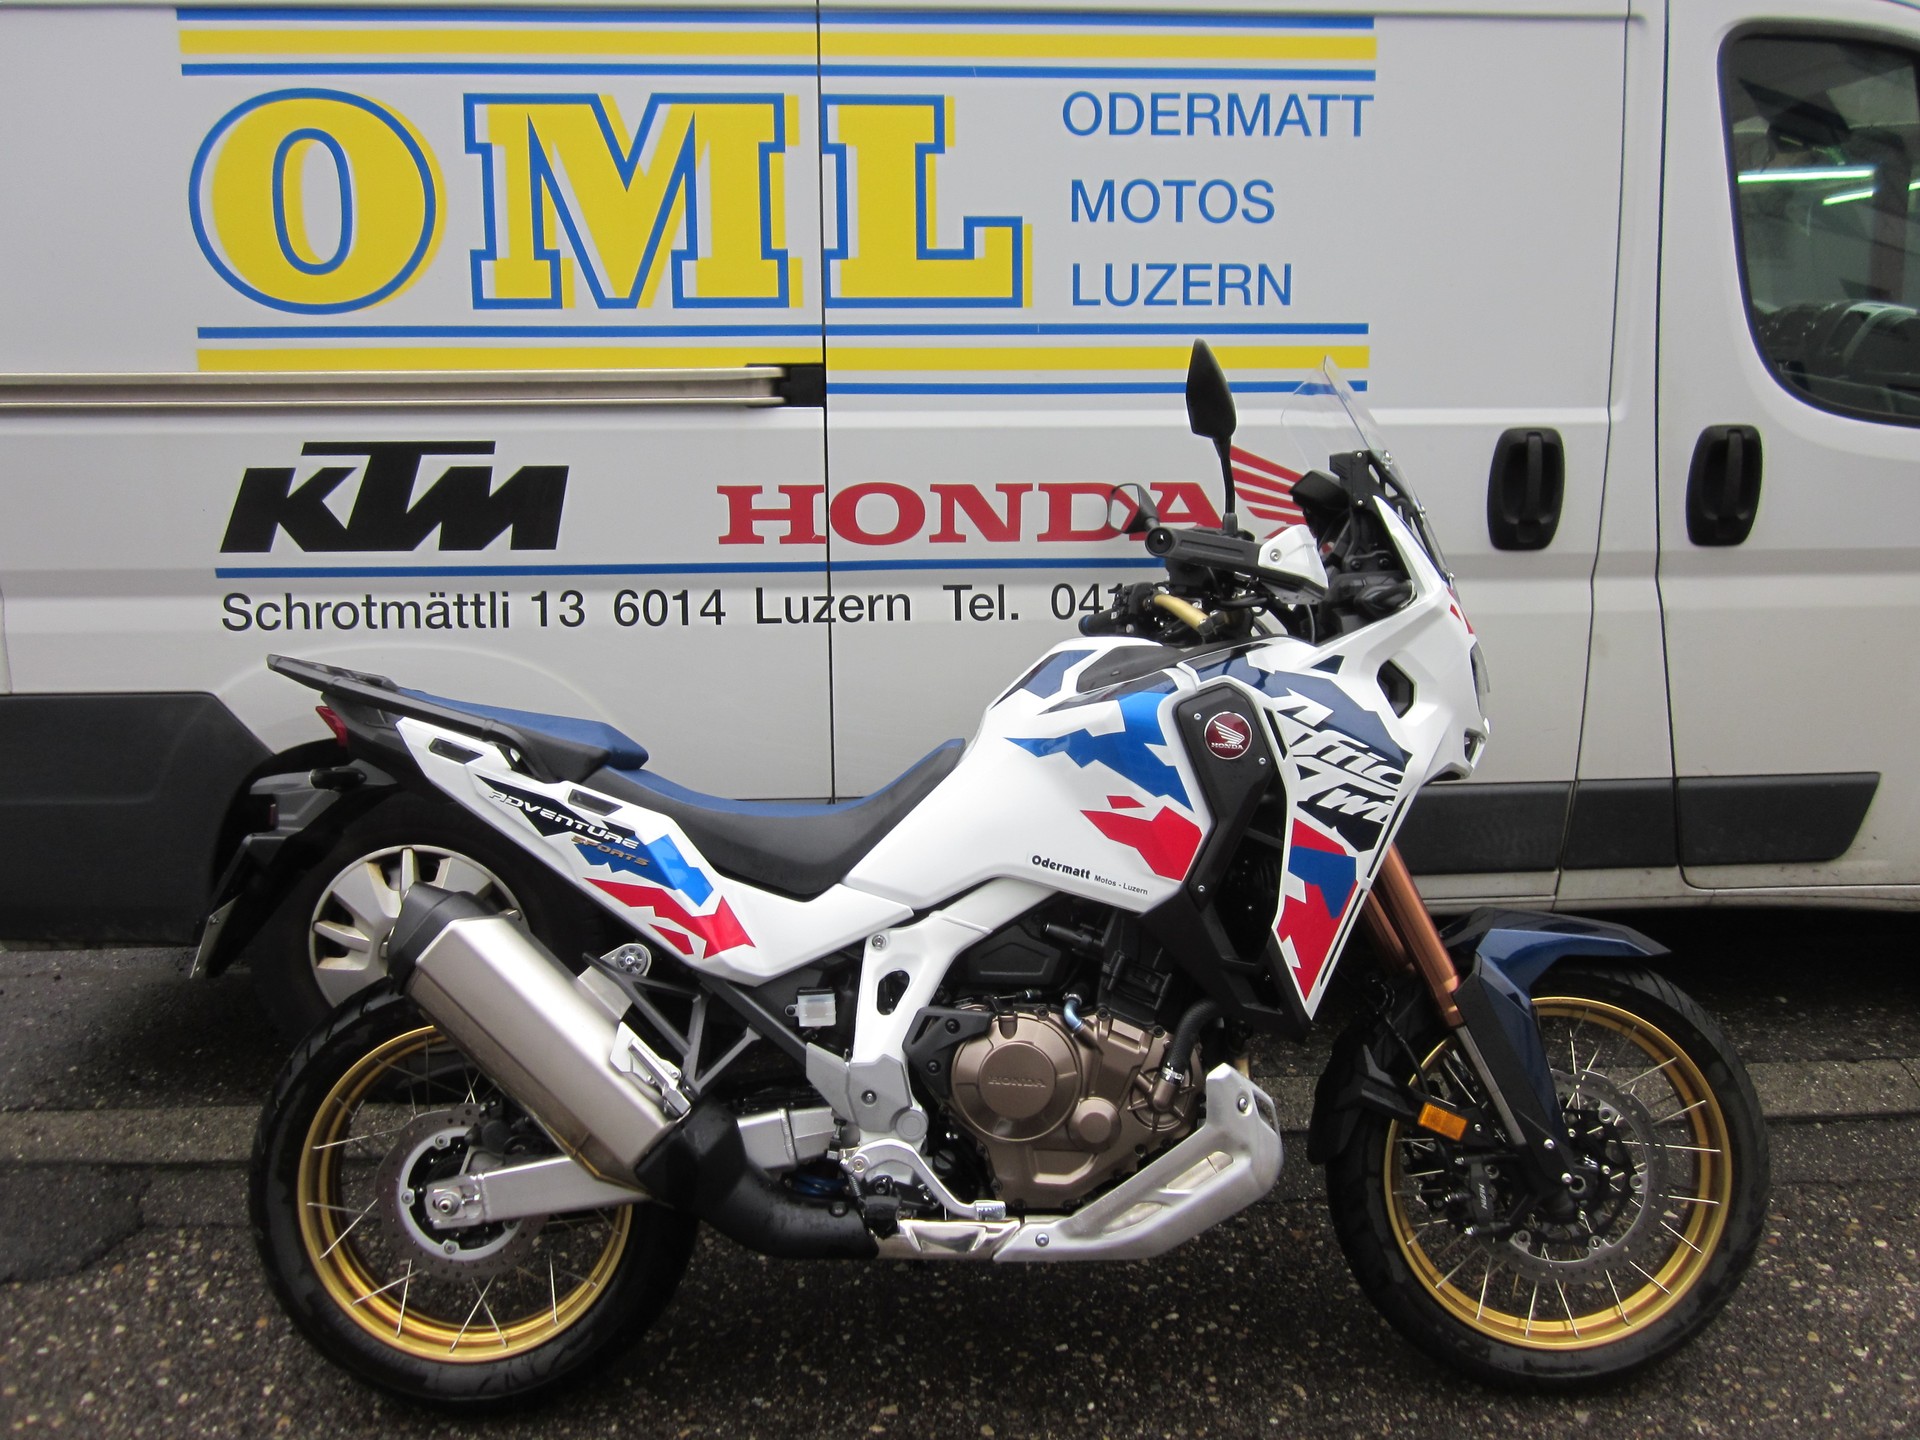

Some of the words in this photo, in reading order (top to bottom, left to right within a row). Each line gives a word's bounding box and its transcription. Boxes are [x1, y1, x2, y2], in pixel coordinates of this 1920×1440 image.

[1062, 90, 1375, 137] ODERMATT
[188, 87, 1033, 314] OML
[1070, 178, 1275, 223] MOTOS
[1072, 262, 1293, 308] LUZERN
[219, 440, 570, 553] KTM
[717, 482, 1224, 545] HONDA
[221, 591, 511, 632] Schrotmättli
[531, 590, 586, 628] 13
[613, 588, 727, 627] 6014
[755, 585, 911, 625] Luzern
[943, 583, 1019, 622] Tel.
[1210, 742, 1244, 750] HONDA
[489, 791, 640, 850] ADVENTURE
[571, 835, 650, 867] SPORTS
[1031, 854, 1091, 880] Odermatt
[1094, 875, 1117, 888] Motos
[1123, 882, 1149, 896] Luzern
[988, 1076, 1046, 1089] HONDA
